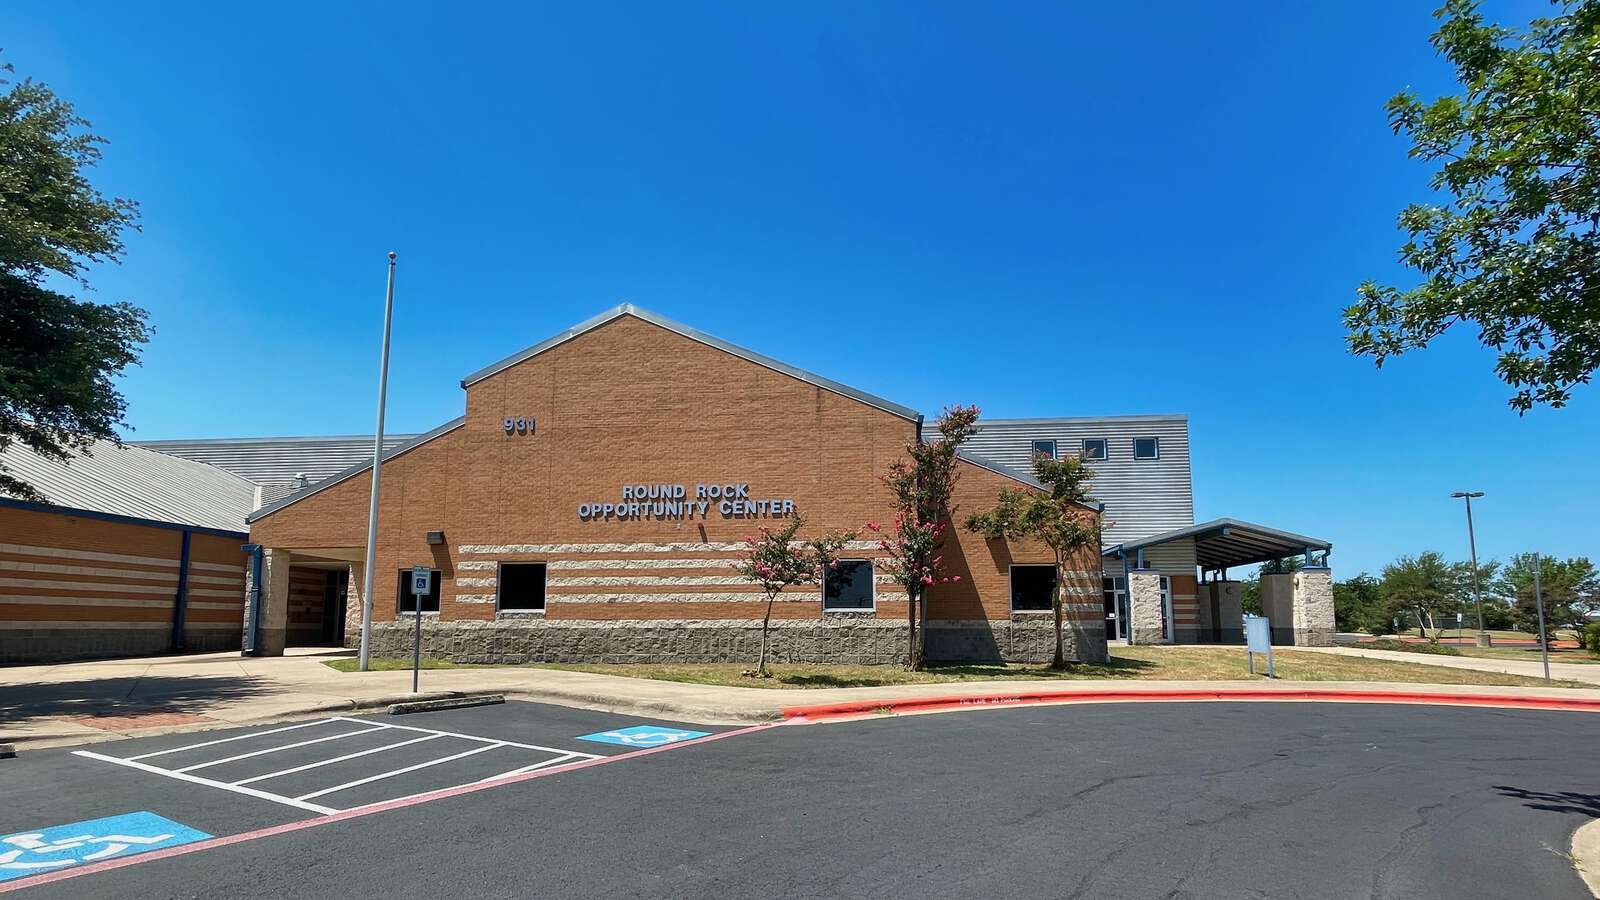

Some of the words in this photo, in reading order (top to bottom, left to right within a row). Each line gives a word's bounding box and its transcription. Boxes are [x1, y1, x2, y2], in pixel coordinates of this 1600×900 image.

[503, 416, 535, 431] 931
[622, 484, 686, 500] ROUND
[696, 483, 750, 499] ROCK
[578, 501, 709, 518] OPPORTUNITY
[719, 499, 794, 516] CENTER
